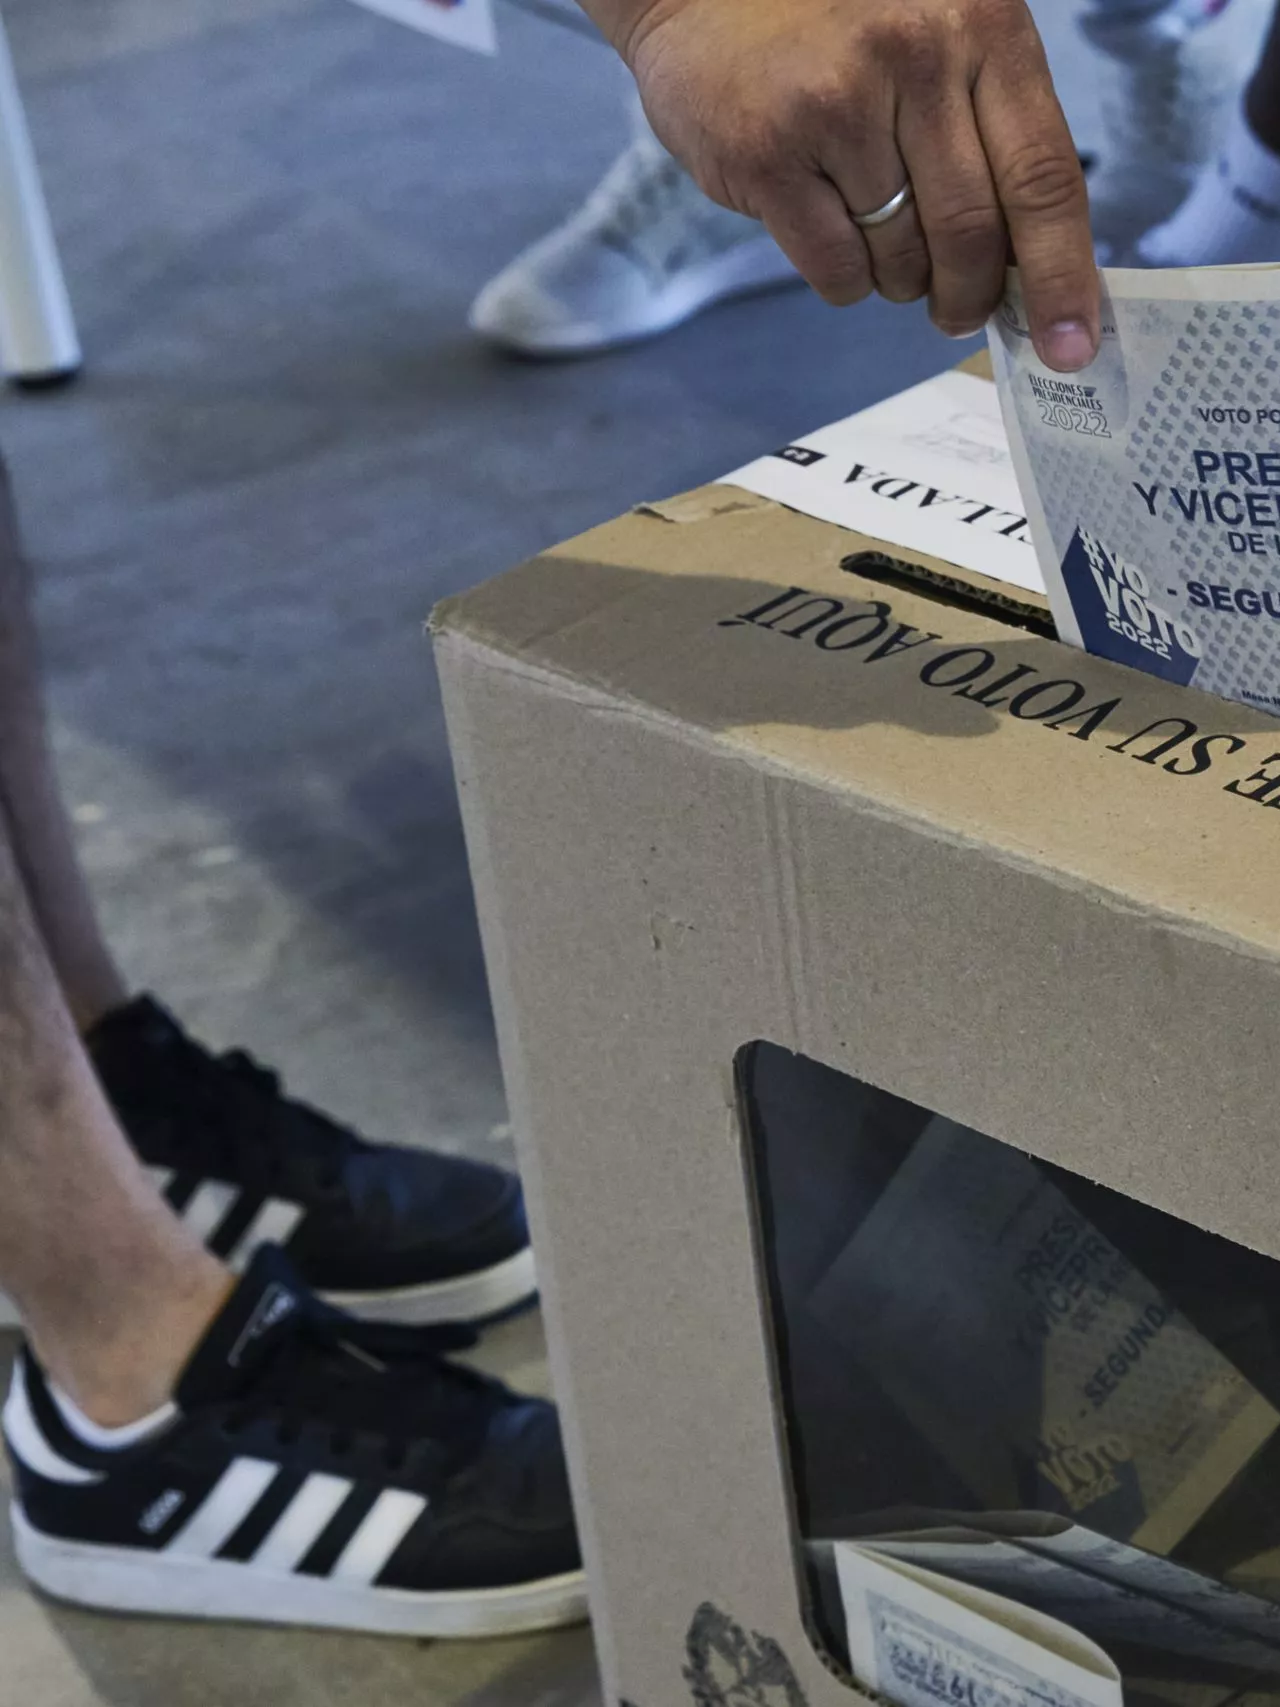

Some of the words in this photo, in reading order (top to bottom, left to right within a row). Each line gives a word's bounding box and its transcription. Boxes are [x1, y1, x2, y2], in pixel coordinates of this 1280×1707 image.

[1028, 373, 1083, 397] ELECCIONES
[1033, 387, 1104, 411] PRESIDENCIALES
[1037, 400, 1112, 439] 2022
[1197, 407, 1250, 424] VOTO
[843, 463, 1034, 546] LLADA
[1132, 482, 1158, 516] Y
[1078, 524, 1149, 599] #YO
[1227, 531, 1267, 555] DE
[718, 586, 943, 664] AQUÍ
[1088, 563, 1200, 658] VOTO
[1105, 611, 1172, 660] 2022
[919, 647, 1123, 742] VOTO
[1105, 717, 1247, 777] SU
[1084, 1301, 1172, 1409] SEGUND
